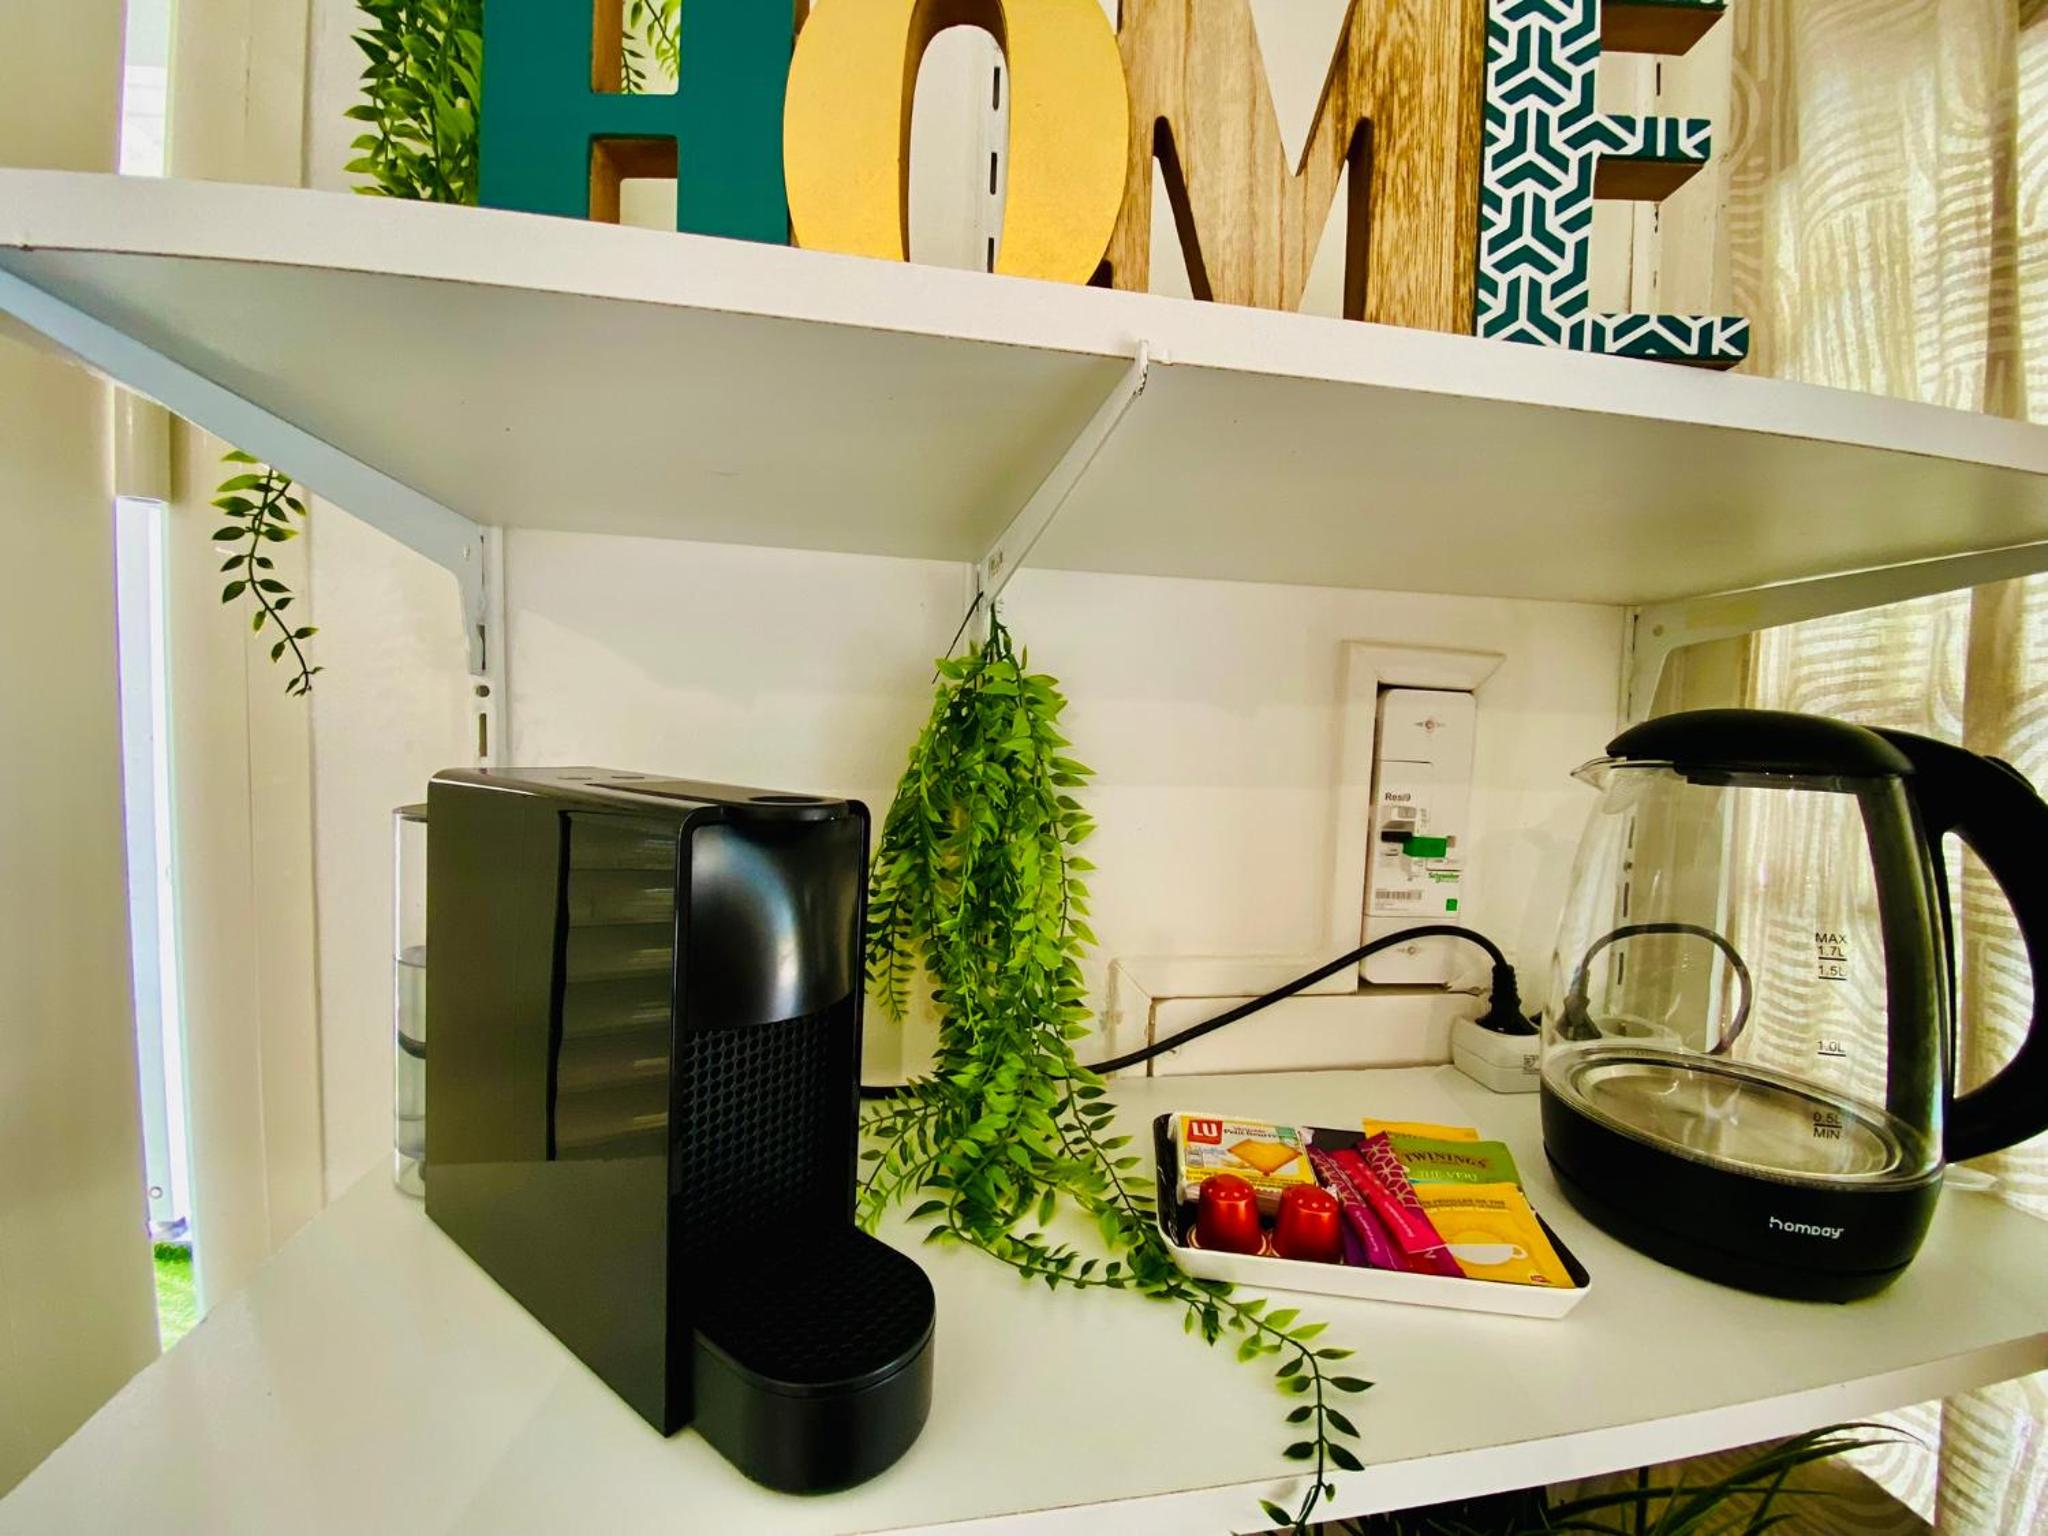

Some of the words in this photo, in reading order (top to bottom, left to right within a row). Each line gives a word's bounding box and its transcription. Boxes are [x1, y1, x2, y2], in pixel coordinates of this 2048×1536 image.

[478, 0, 1749, 362] HOME
[1815, 932, 1847, 944] MAX
[1818, 945, 1845, 957] 1.7L
[1818, 965, 1846, 977] 1.5L
[1816, 1041, 1845, 1053] 1.0L
[1813, 1112, 1841, 1124] 0.5L
[1191, 1121, 1218, 1137] LU
[1813, 1127, 1840, 1140] MIN
[1403, 1150, 1489, 1168] TWININGS
